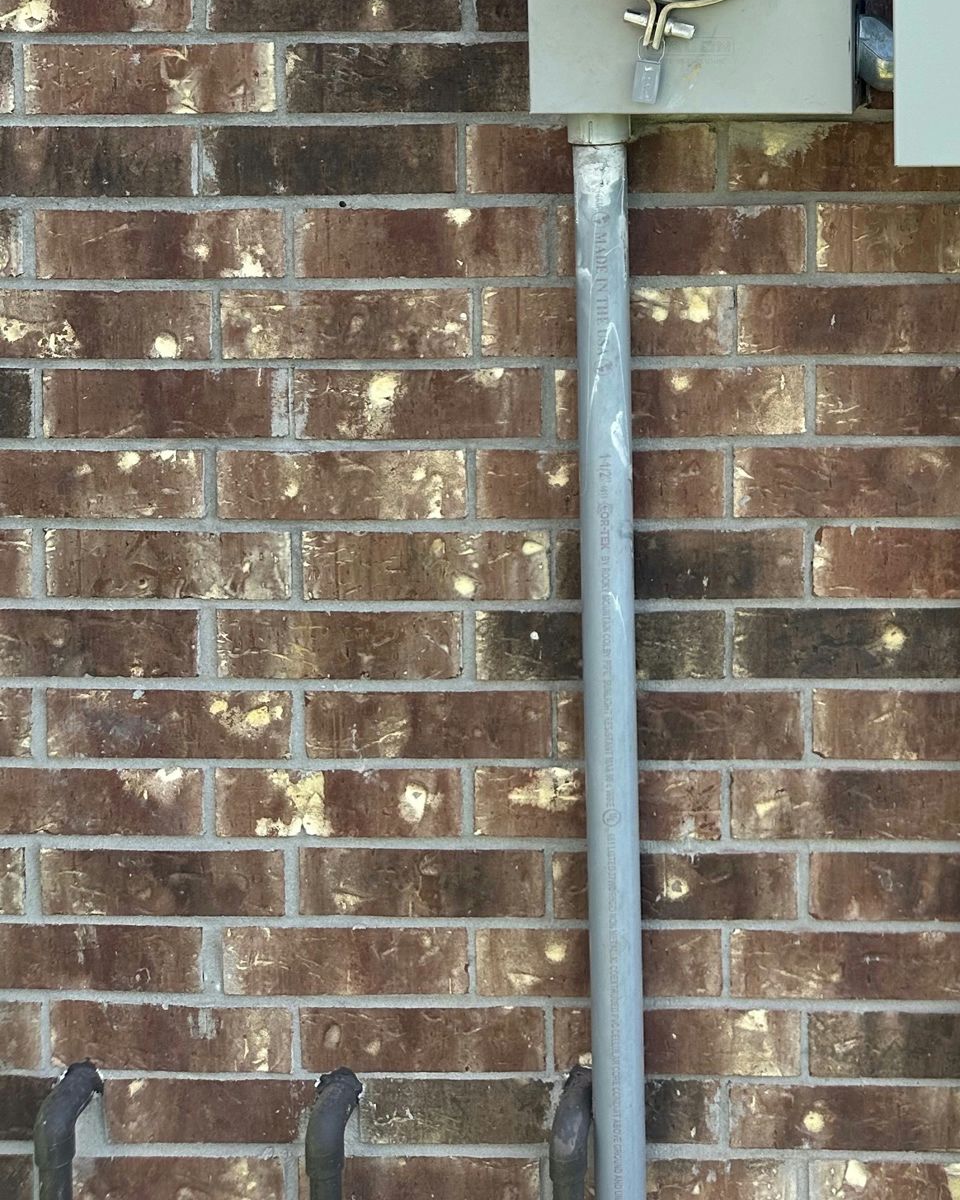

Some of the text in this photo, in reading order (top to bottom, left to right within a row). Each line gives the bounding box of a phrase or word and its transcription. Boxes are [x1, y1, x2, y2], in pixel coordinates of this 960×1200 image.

[595, 232, 609, 356] MADE IN THE USA
